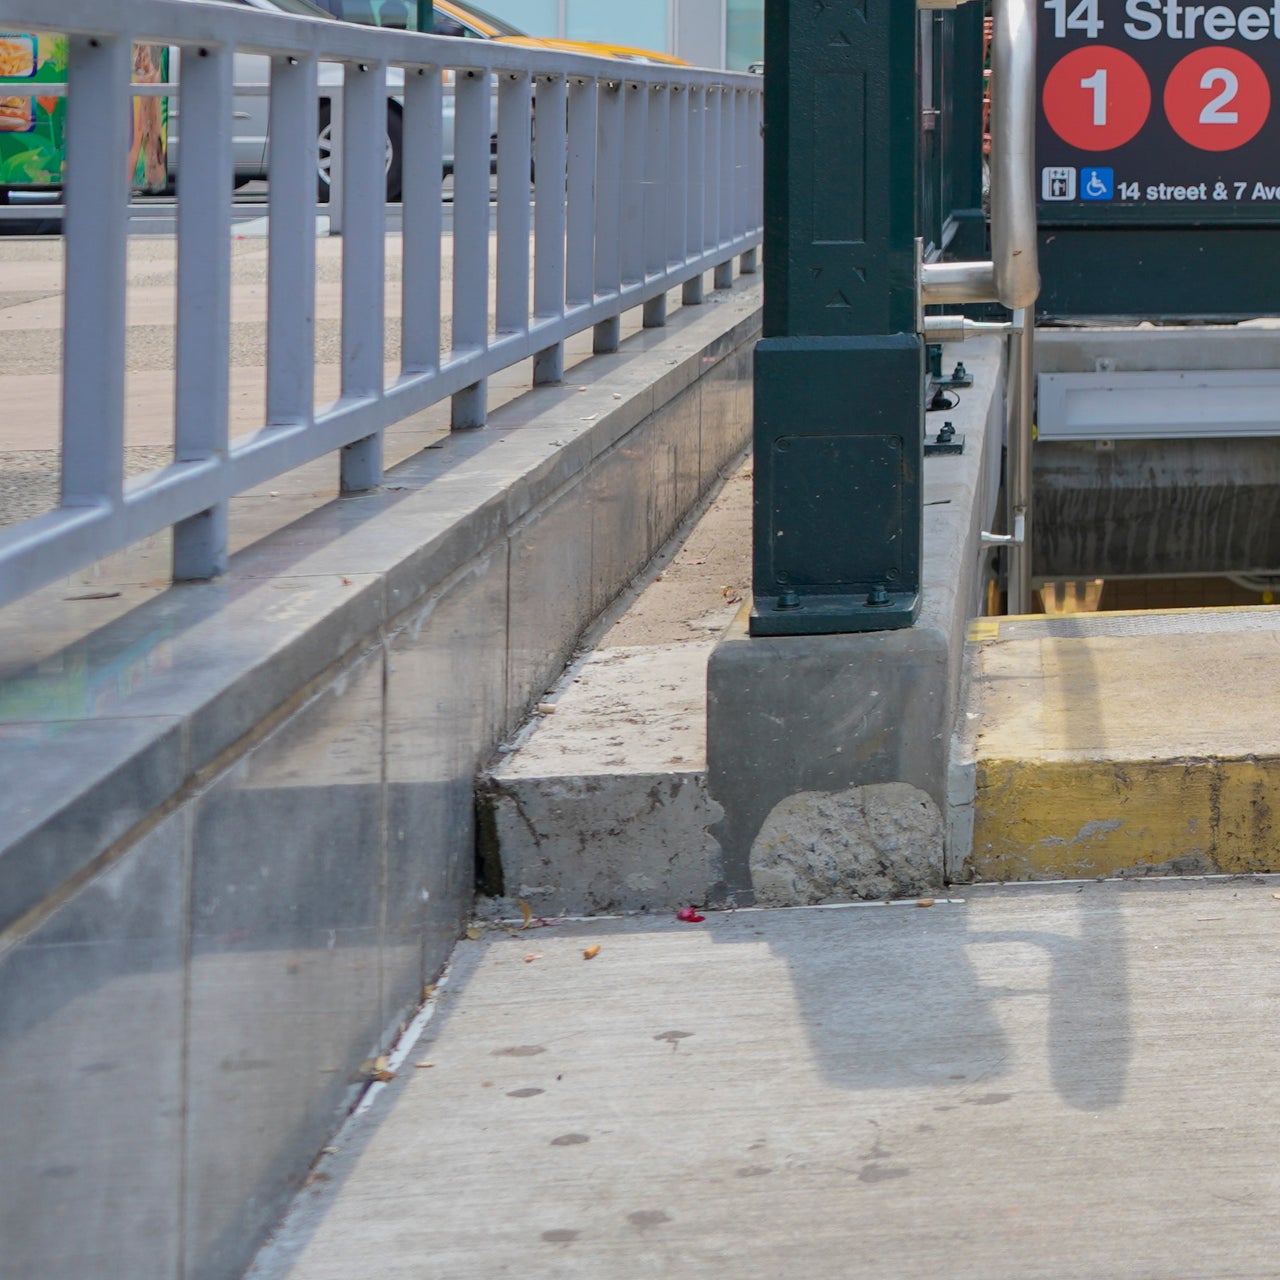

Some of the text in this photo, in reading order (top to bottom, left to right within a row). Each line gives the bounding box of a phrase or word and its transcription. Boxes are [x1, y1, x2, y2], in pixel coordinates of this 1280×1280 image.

[1080, 69, 1108, 126] 1
[1198, 67, 1239, 124] 2
[1117, 182, 1140, 200] 14
[1146, 183, 1207, 200] street
[1212, 182, 1228, 200] &
[1234, 183, 1248, 200] 7
